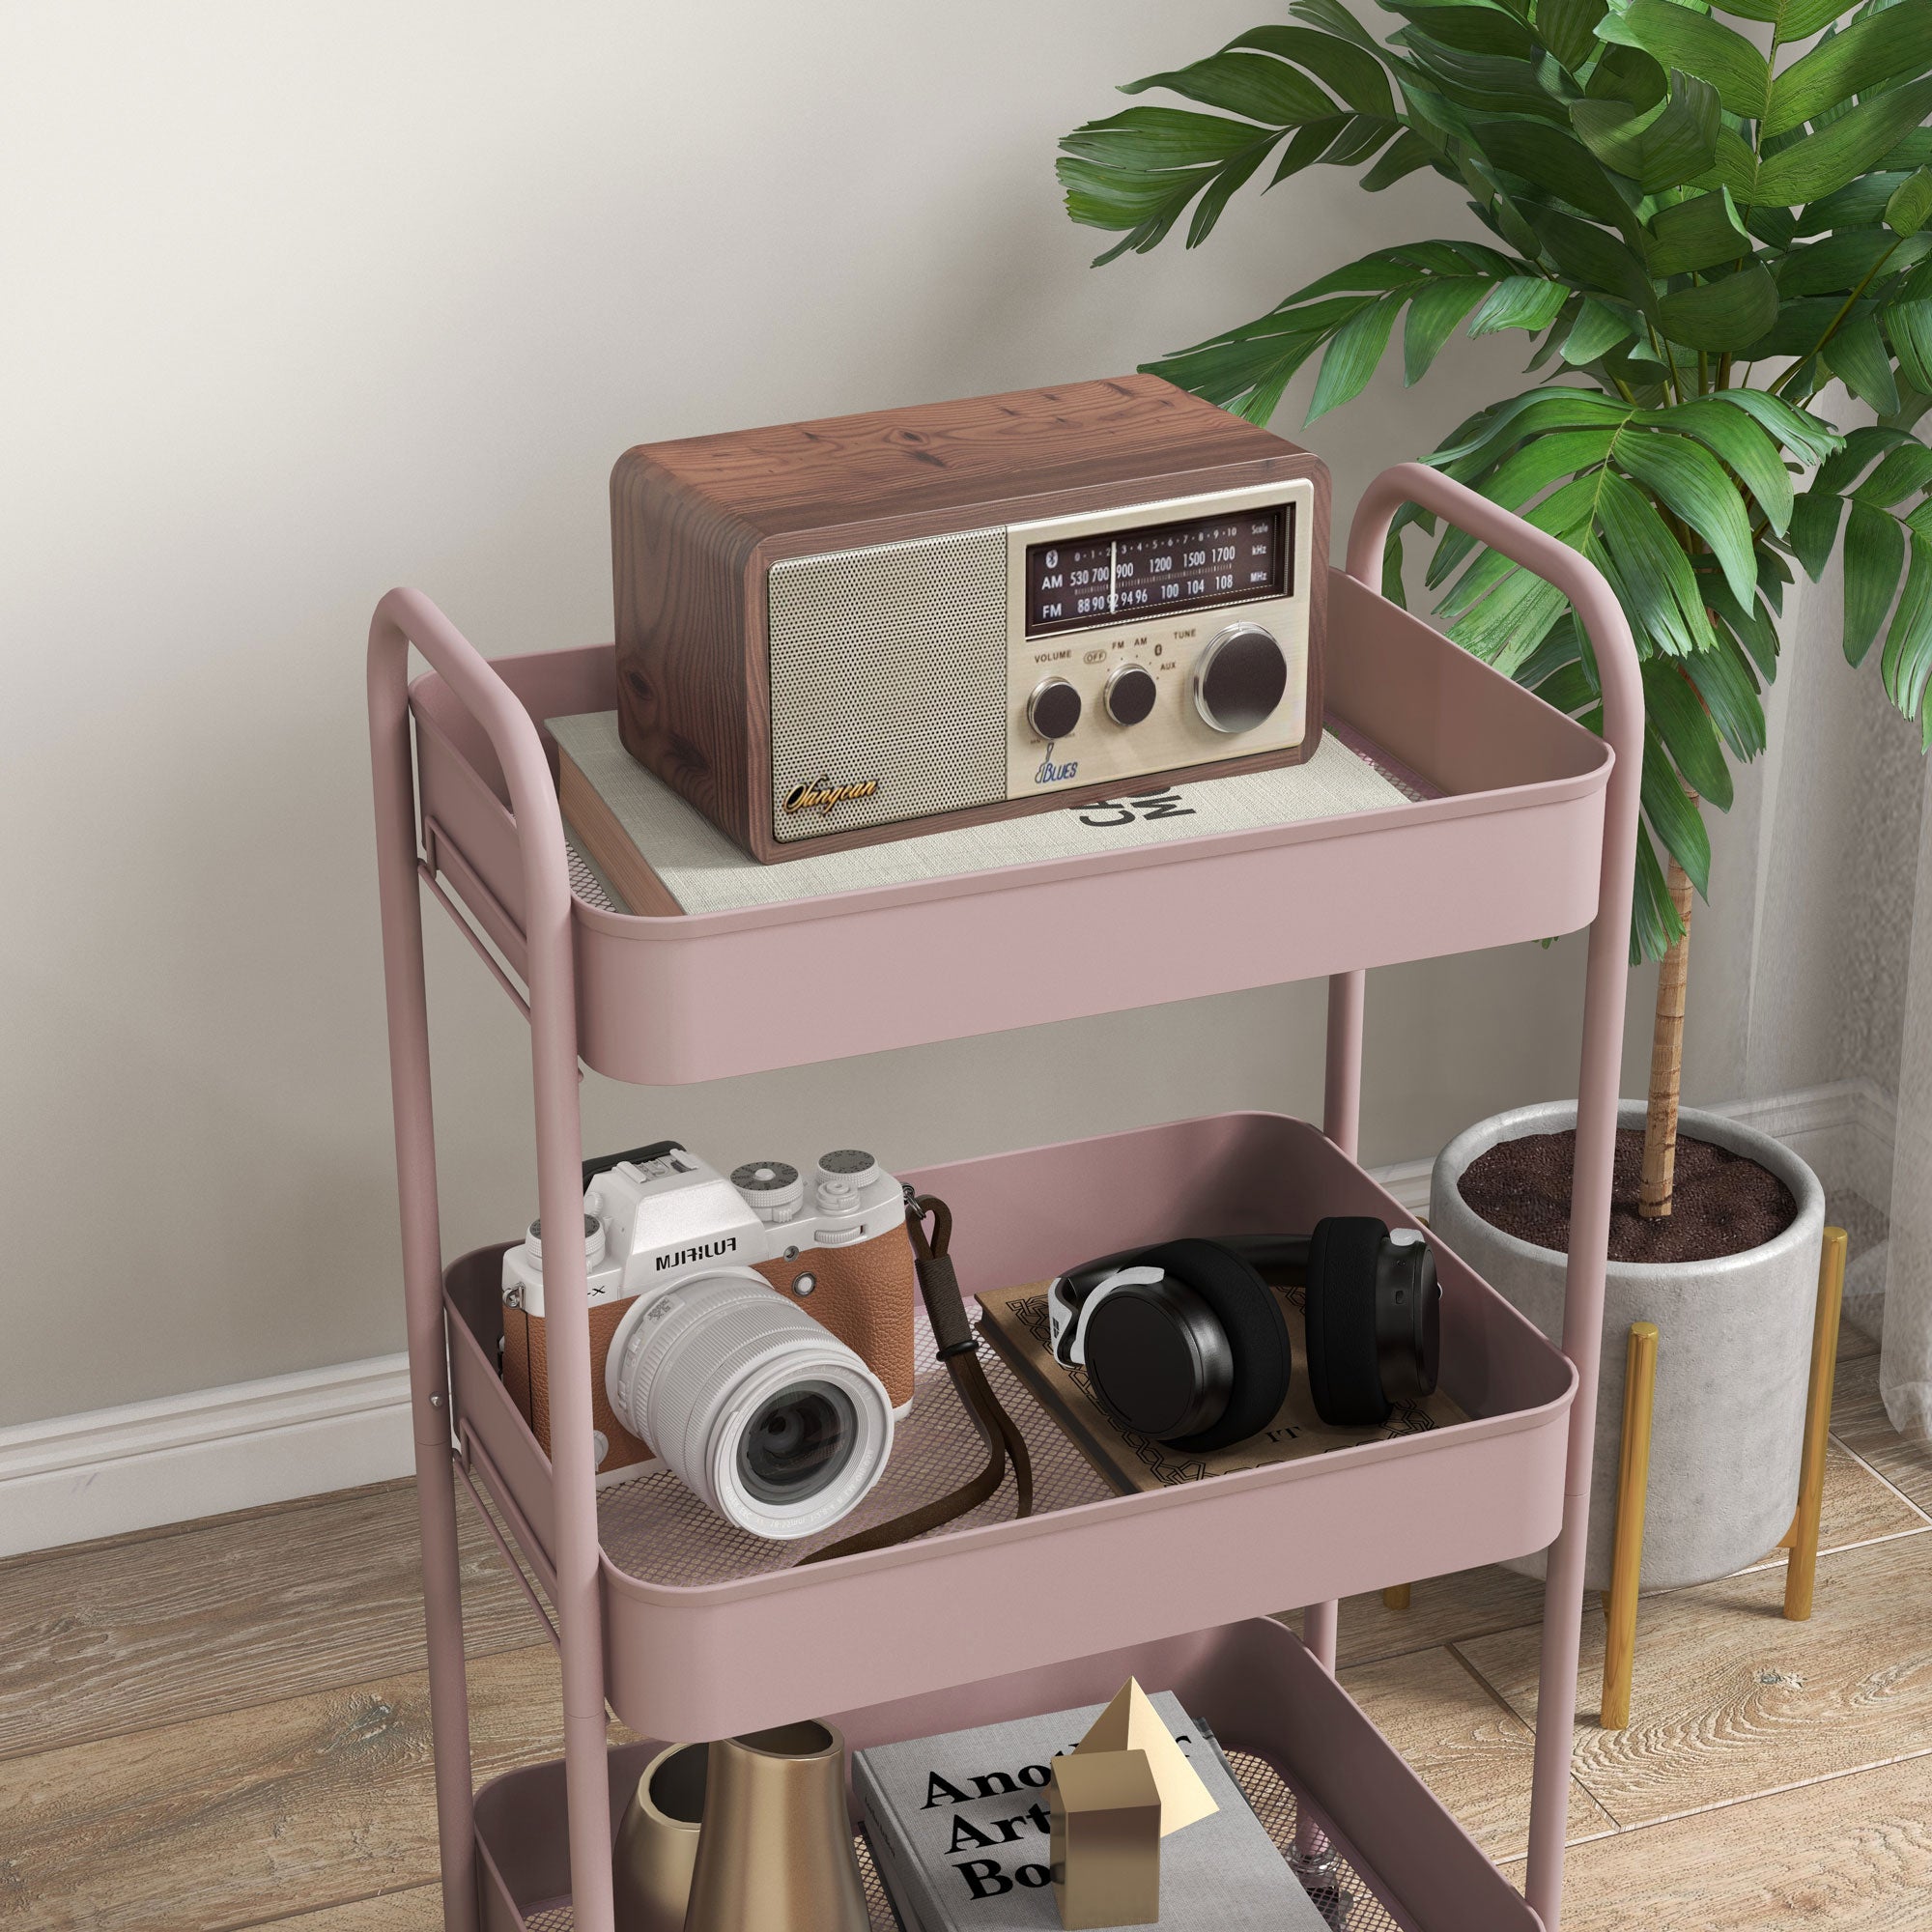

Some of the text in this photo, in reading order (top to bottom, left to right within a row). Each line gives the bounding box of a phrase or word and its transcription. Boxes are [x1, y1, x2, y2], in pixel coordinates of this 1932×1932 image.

[1121, 544, 1127, 554] 3
[1137, 542, 1142, 552] 4
[1151, 539, 1158, 550] 5
[1167, 537, 1174, 547] 6
[1182, 534, 1188, 544] 7
[1213, 529, 1219, 539] 9
[1227, 526, 1236, 537] 10
[1041, 544, 1266, 590] AM 530 700 900 1200 1500 1700 kHz
[1043, 603, 1062, 618] FM
[1077, 598, 1091, 613] 88
[1092, 595, 1105, 611] 90
[1121, 590, 1133, 607] 94
[1135, 588, 1148, 604] 96
[1161, 582, 1179, 599] 100
[1187, 579, 1205, 595] 104
[1215, 574, 1233, 590] 108
[1250, 571, 1267, 582] MHz
[1173, 628, 1196, 639] TUNE
[1112, 640, 1124, 650] FM
[1134, 637, 1148, 646] AM
[1035, 649, 1072, 664] VOLUME
[1086, 652, 1104, 663] OFF
[1160, 661, 1176, 671] AUX
[1042, 760, 1079, 783] BLUES
[944, 1803, 1051, 1855] Art
